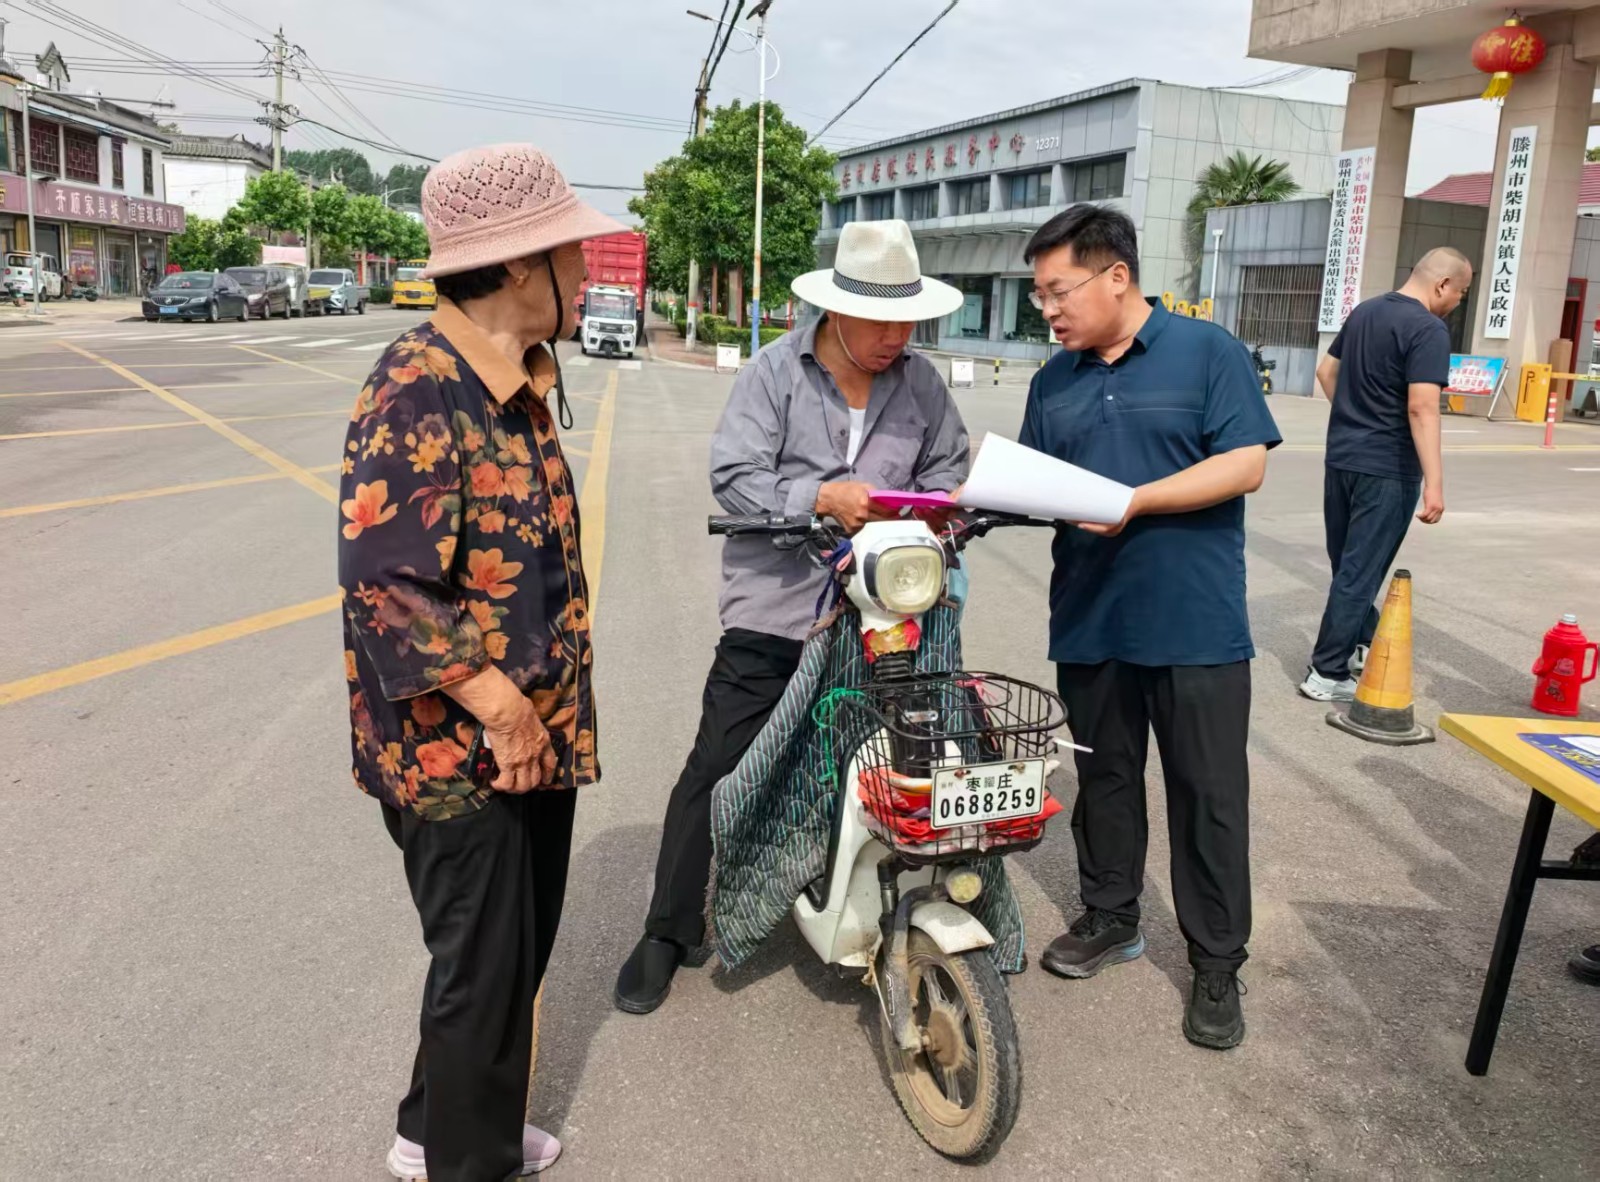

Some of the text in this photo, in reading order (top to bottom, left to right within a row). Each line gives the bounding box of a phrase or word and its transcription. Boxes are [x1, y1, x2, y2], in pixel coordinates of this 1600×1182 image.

[1035, 135, 1060, 151] 12371
[1321, 158, 1352, 326] 滕州市监察委员会派出柴胡店镇监察室
[1488, 136, 1531, 329] 滕州市柴胡店镇人民政府
[966, 773, 1013, 792] 枣庄
[940, 786, 1036, 819] 0688259
